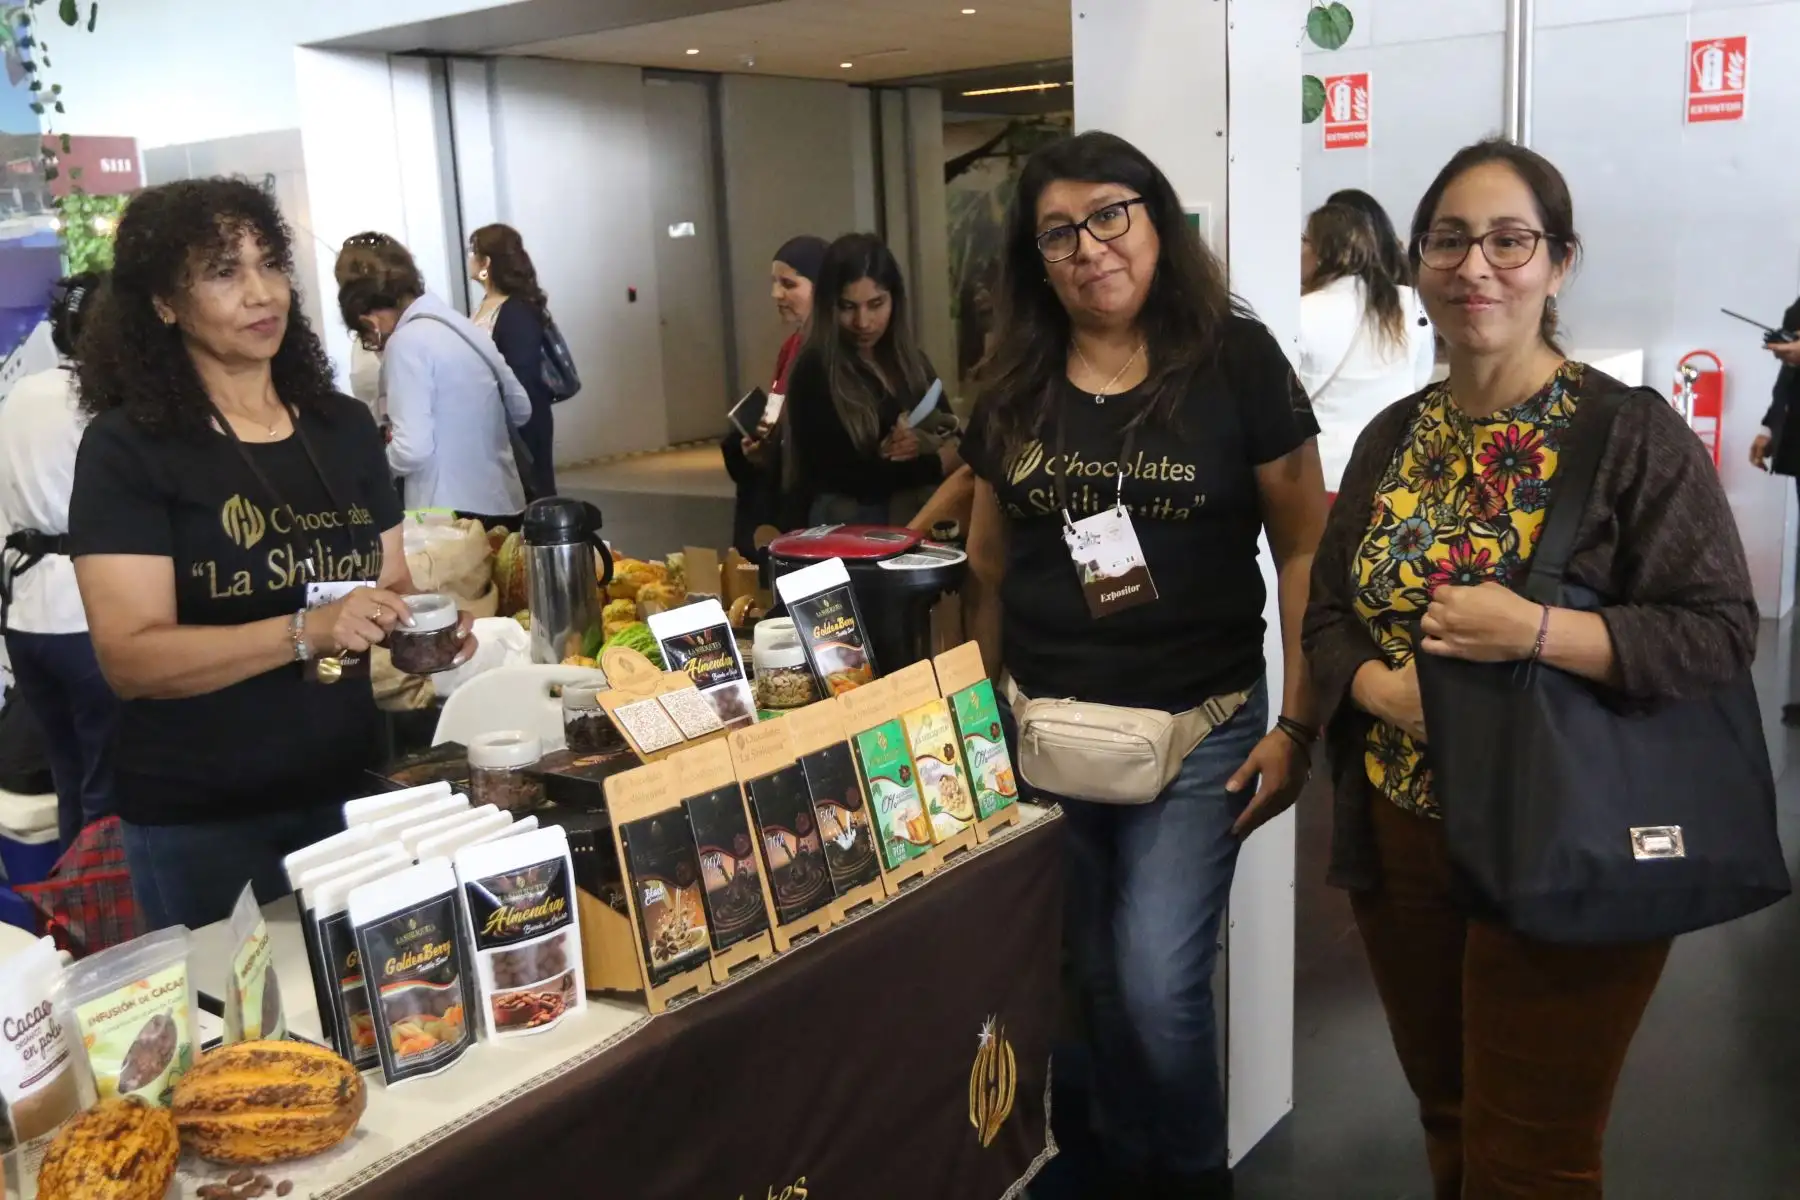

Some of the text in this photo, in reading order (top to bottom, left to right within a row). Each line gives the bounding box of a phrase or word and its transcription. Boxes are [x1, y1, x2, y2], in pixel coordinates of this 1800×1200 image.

[1044, 450, 1196, 482] Chocolates
[1100, 584, 1141, 603] Expositor
[3, 999, 53, 1042] Cacao
